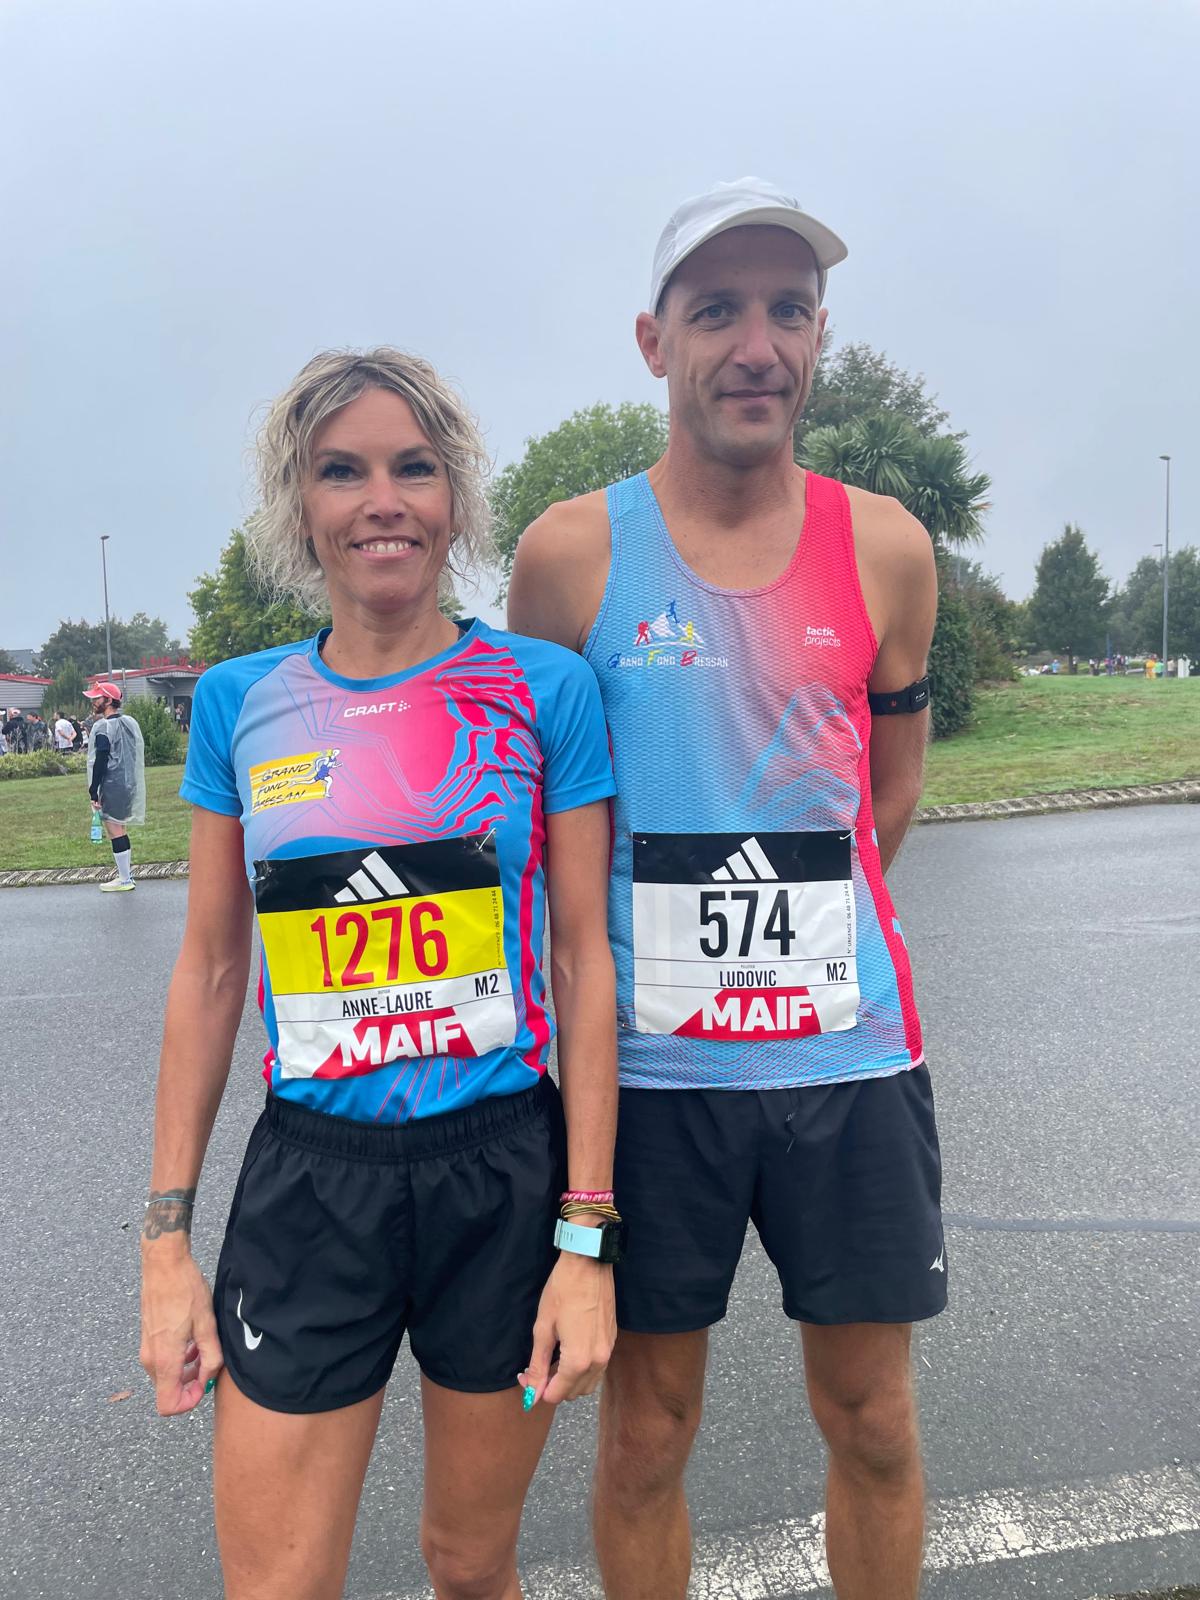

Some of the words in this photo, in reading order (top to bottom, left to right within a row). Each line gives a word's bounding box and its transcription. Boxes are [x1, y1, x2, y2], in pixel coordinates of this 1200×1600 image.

[804, 636, 841, 648] projects
[806, 626, 835, 637] tactic
[343, 702, 397, 718] CRAFT
[261, 763, 312, 782] GRAND
[699, 889, 796, 958] 574
[310, 901, 449, 988] 1276
[719, 970, 777, 987] LUDOVIC
[826, 961, 848, 982] M2
[474, 973, 500, 997] M2
[342, 990, 434, 1018] ANNE-LAURE
[701, 995, 813, 1032] MAIF
[338, 1018, 462, 1067] MAIF
